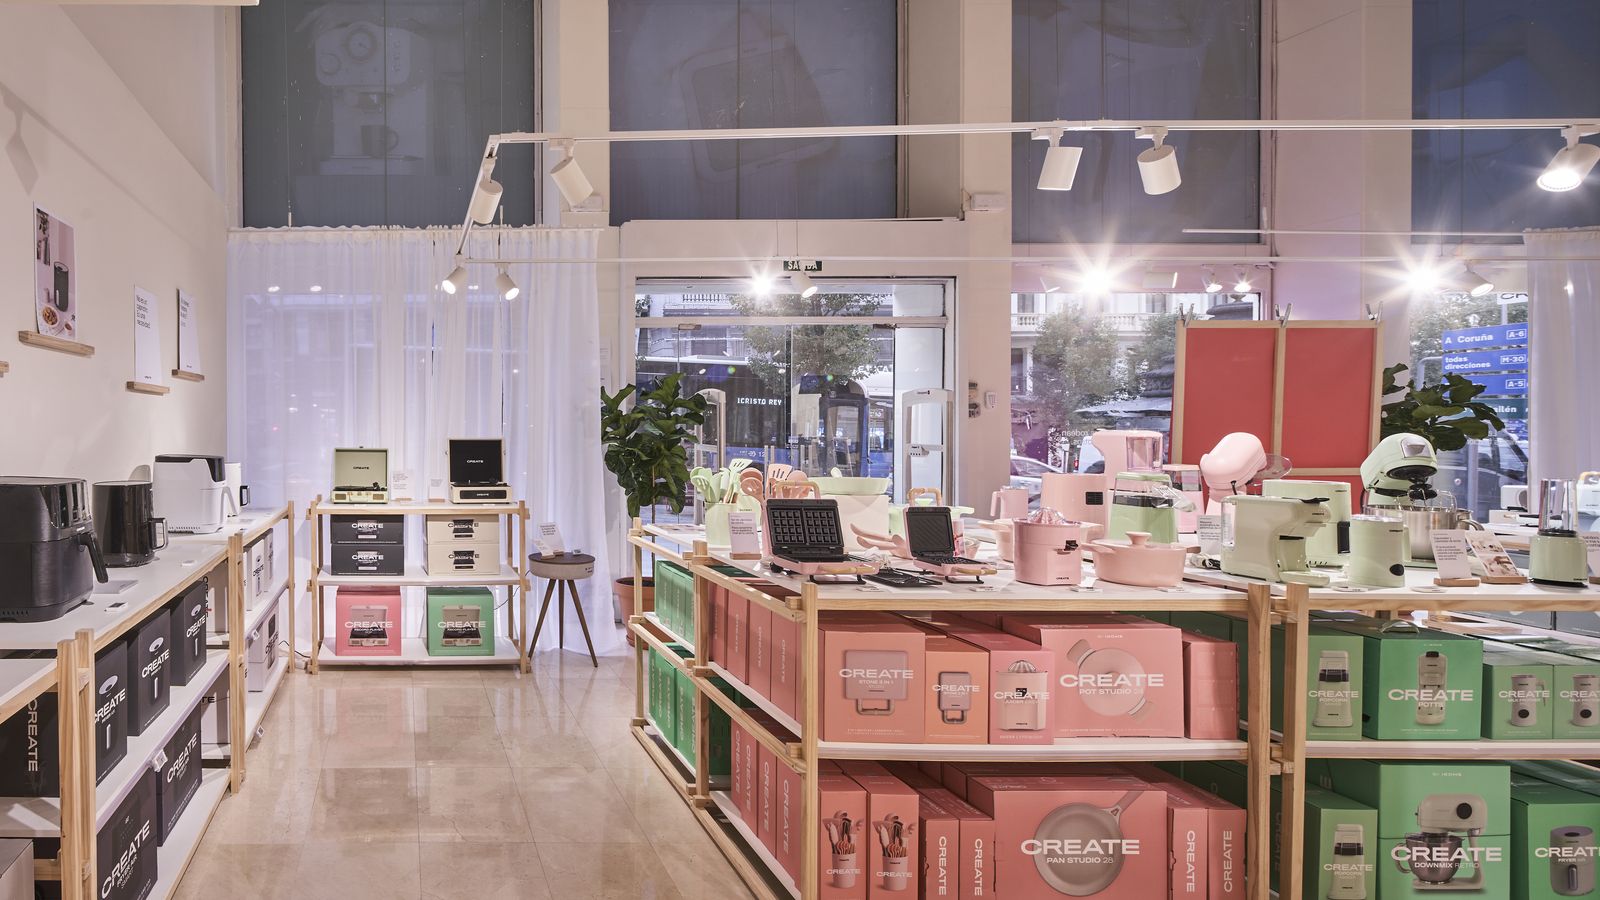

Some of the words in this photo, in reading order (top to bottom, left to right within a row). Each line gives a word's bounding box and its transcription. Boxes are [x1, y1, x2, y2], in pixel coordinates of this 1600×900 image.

[1458, 334, 1494, 343] Coruña
[142, 650, 170, 678] CREATE
[839, 668, 914, 679] CREATE
[1060, 674, 1164, 687] CREATE
[994, 692, 1050, 700] CREATE
[1388, 689, 1474, 701] CREATE
[27, 700, 39, 772] CREATE
[167, 733, 198, 784] CREATE
[1020, 839, 1140, 855] CREATE
[1390, 846, 1502, 862] CREATE
[1535, 847, 1600, 858] CREAT
[102, 819, 150, 900] CREATE
[974, 839, 982, 896] CREATE
[1186, 830, 1196, 893] CREATE
[1224, 830, 1232, 893] CREATE
[1323, 864, 1373, 872] CREATE
